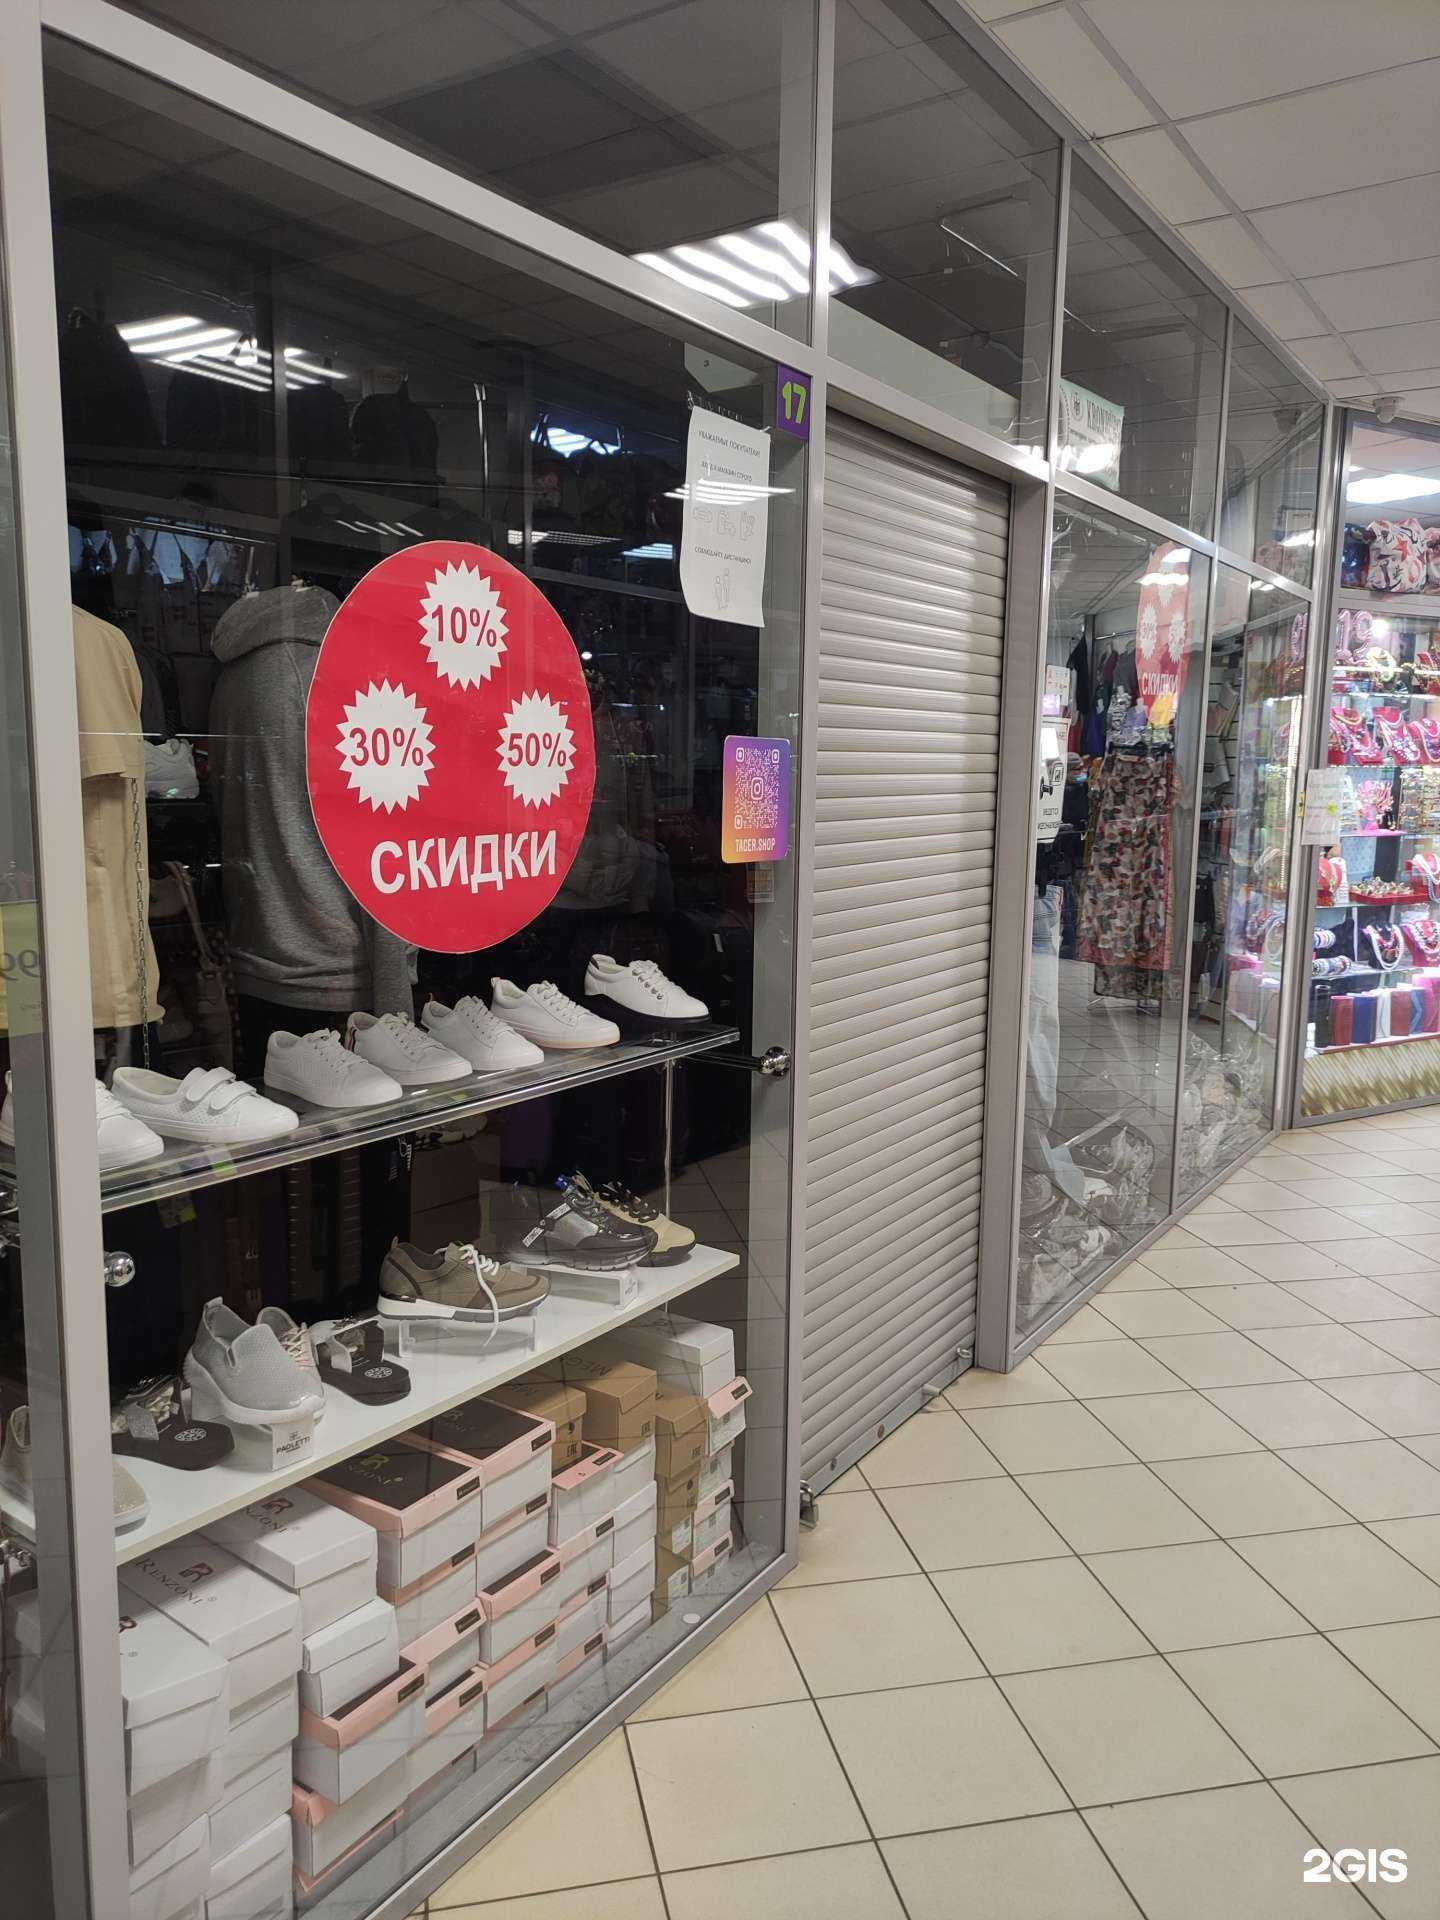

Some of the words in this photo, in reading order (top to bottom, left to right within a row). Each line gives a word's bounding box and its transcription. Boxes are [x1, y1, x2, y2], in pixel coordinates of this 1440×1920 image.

[781, 381, 807, 425] 17
[430, 604, 498, 648] 10%
[348, 727, 425, 768] 30%
[506, 731, 568, 769] 50%
[369, 829, 558, 895] СКИДКИ
